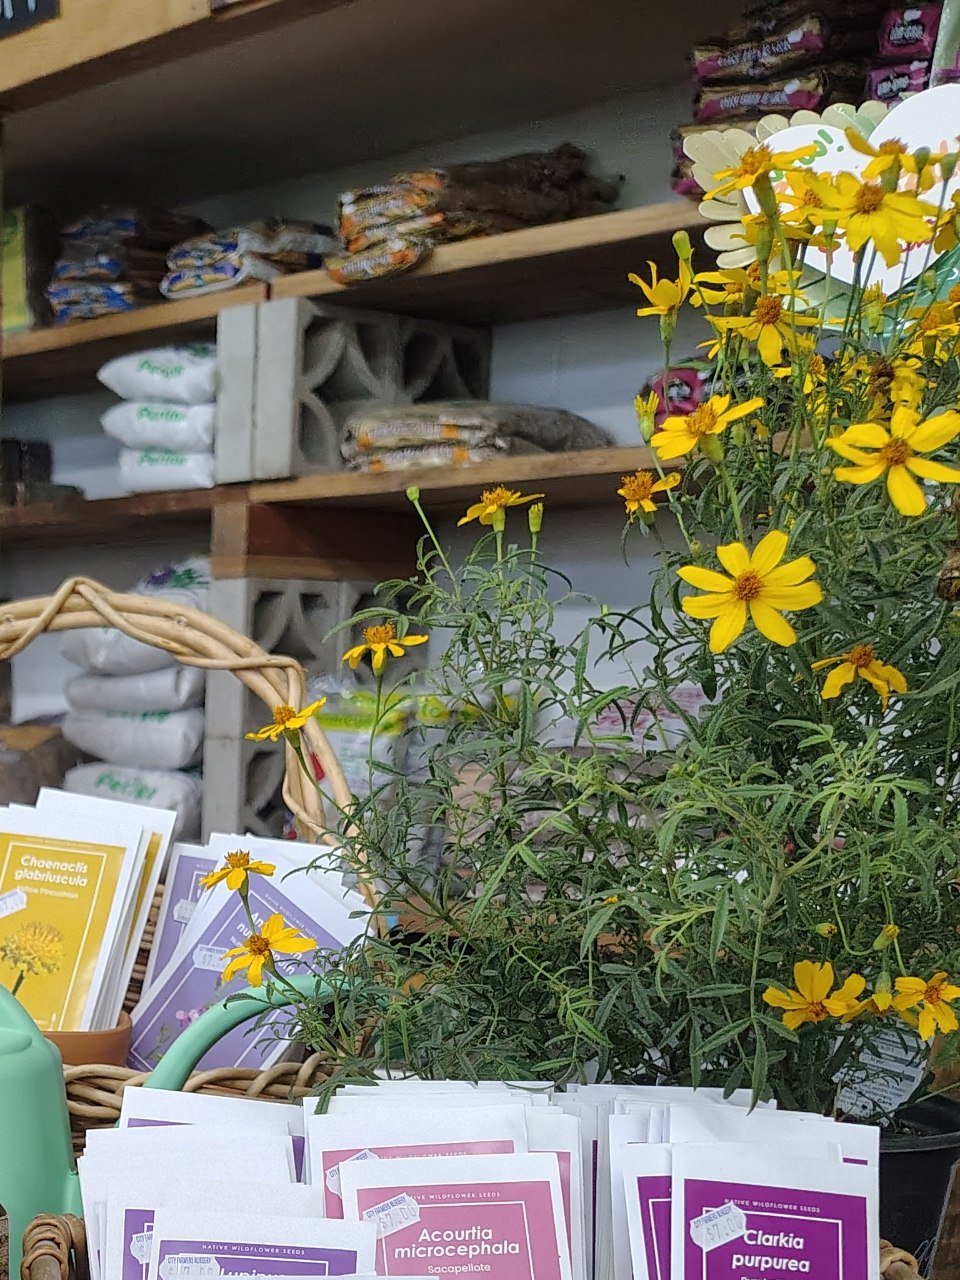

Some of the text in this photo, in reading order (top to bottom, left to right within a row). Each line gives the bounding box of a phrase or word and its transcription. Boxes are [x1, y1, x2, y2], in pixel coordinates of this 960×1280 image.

[20, 855, 88, 874] Chaenactis
[14, 868, 88, 887] glabriuscula
[429, 1192, 477, 1200] WILDFLOWER
[752, 1201, 798, 1211] WILDFLOWER
[417, 1226, 493, 1242] Acourtia
[706, 1215, 744, 1242] $7.00
[743, 1229, 805, 1250] Clarkia
[231, 1245, 280, 1254] WILDFLOWER
[394, 1240, 520, 1259] microcephala
[427, 1262, 491, 1276] Sacapellote
[731, 1254, 811, 1273] purpurea
